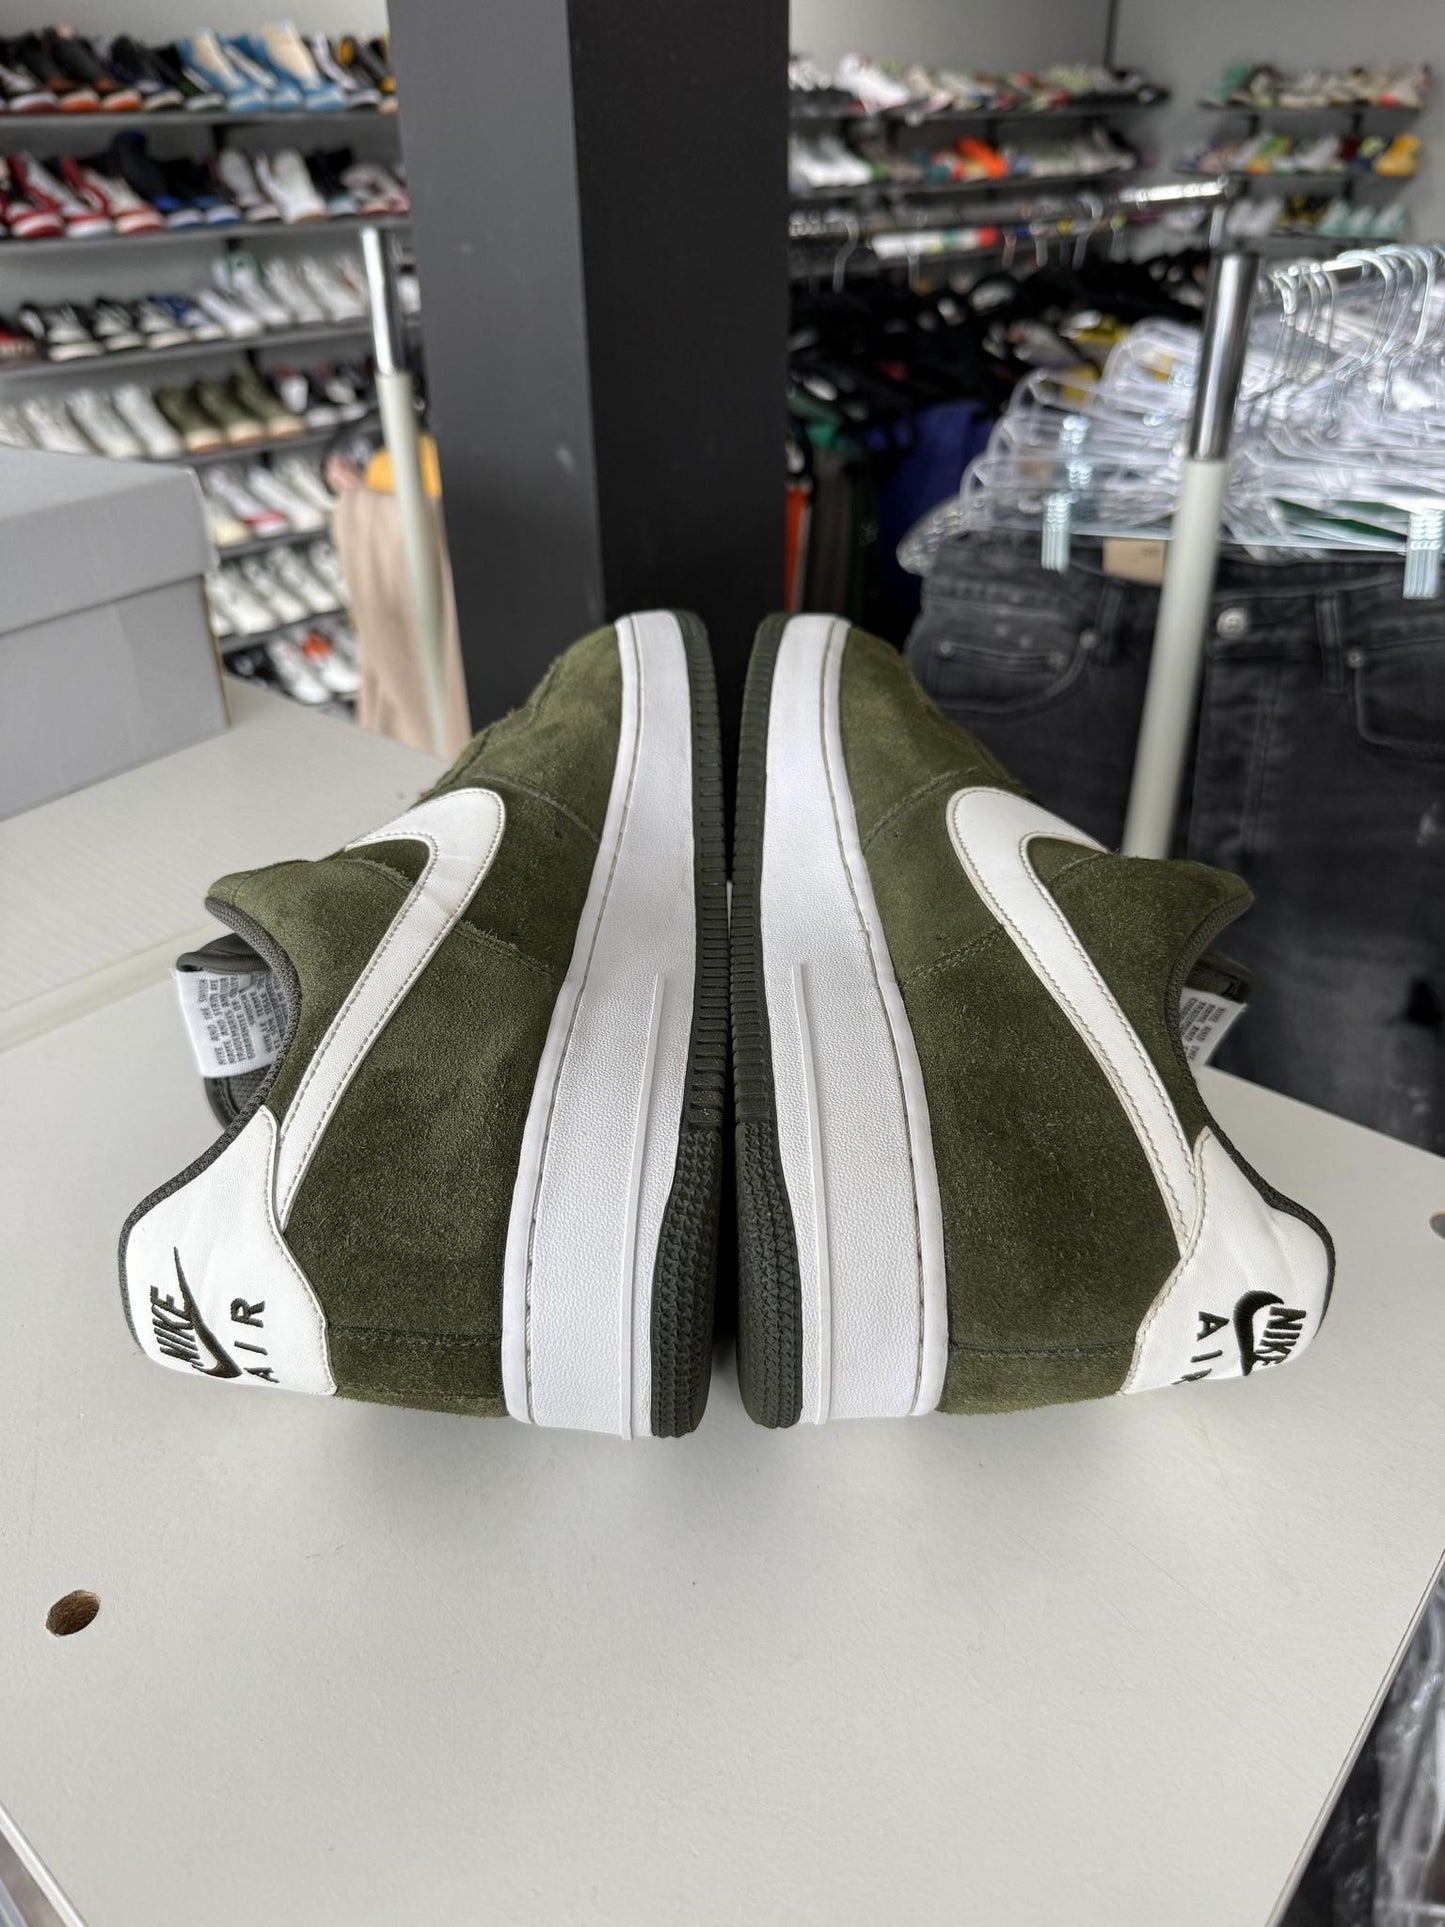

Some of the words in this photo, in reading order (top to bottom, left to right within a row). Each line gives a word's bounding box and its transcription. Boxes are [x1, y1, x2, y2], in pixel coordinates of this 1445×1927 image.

[200, 1006, 212, 1019] THE
[231, 999, 241, 1011] OF
[207, 1023, 219, 1041] AND
[216, 1018, 229, 1036] AND
[224, 1010, 246, 1061] TRADEMARKS
[214, 1046, 226, 1065] NIKE
[150, 1285, 204, 1366] NIKE
[230, 1297, 280, 1383] AIR
[1255, 1306, 1307, 1366] NIKE
